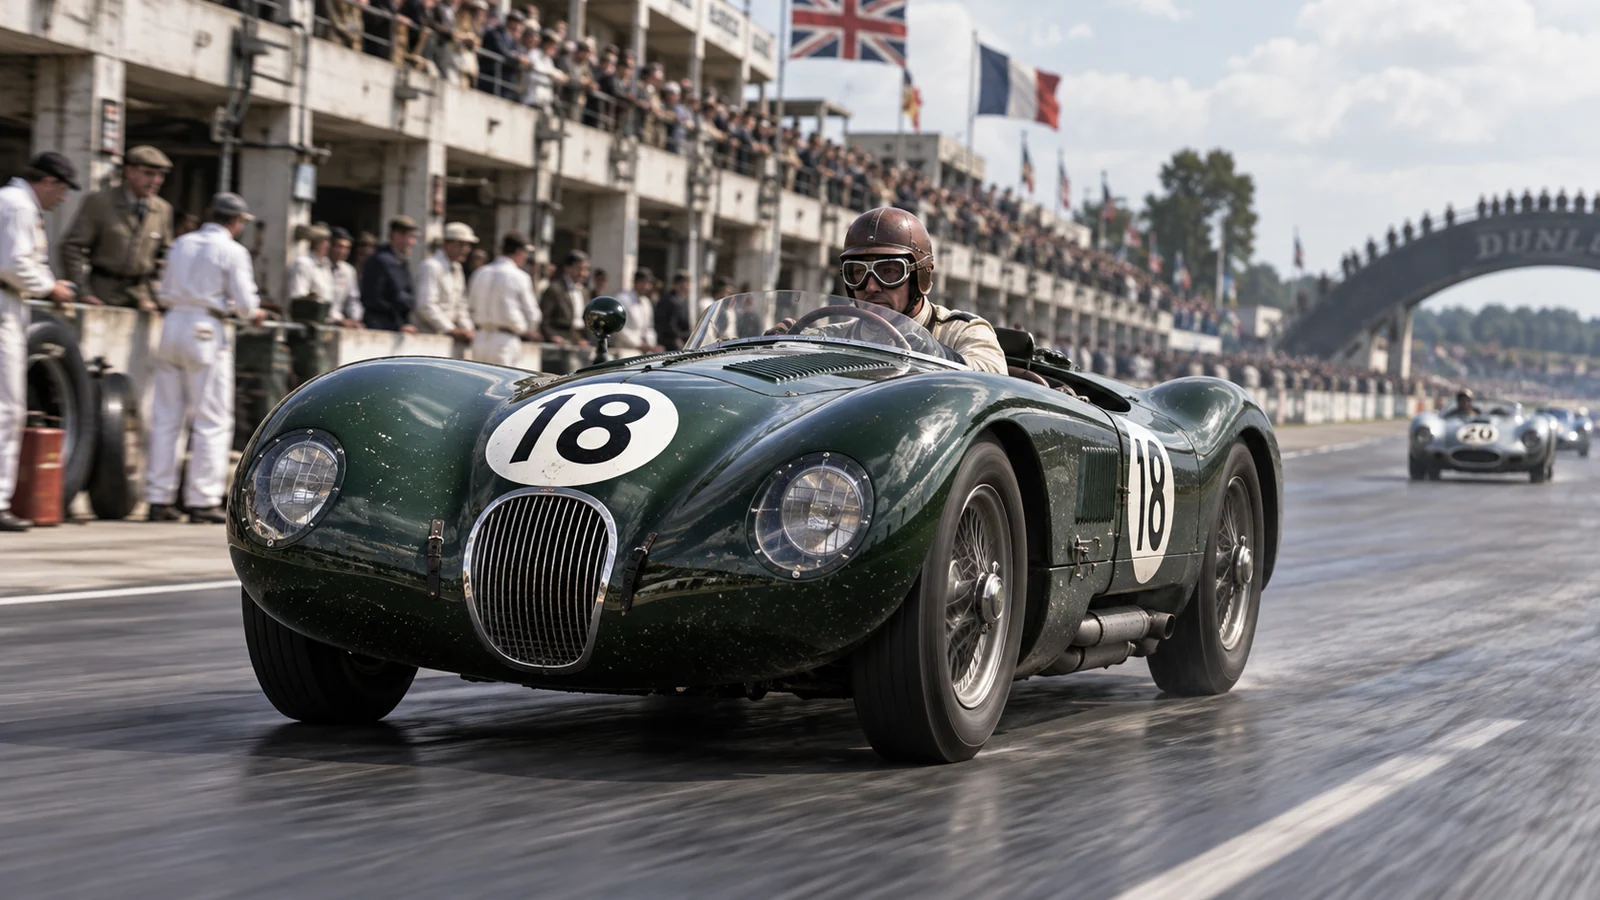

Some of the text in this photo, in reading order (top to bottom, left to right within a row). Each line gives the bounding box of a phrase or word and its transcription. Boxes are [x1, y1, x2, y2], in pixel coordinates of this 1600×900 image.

[509, 393, 650, 465] 18
[1462, 427, 1492, 441] 20
[1134, 438, 1166, 551] 18
